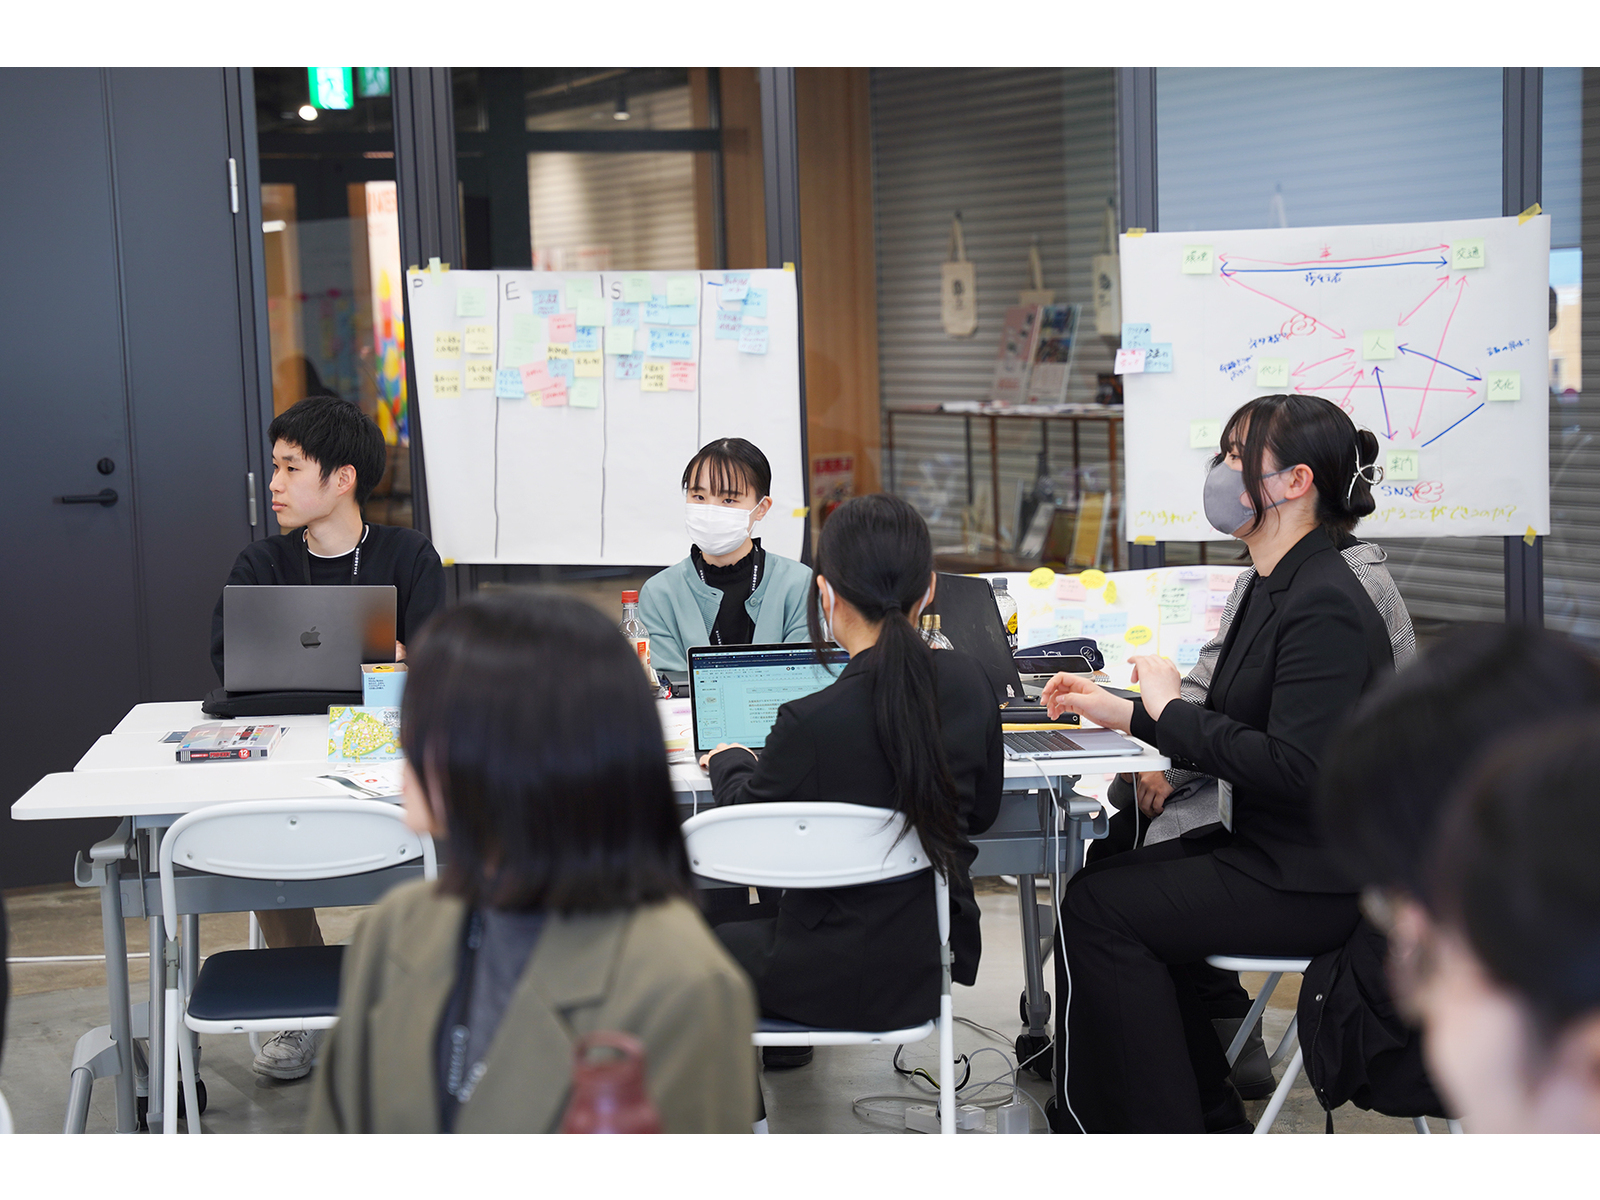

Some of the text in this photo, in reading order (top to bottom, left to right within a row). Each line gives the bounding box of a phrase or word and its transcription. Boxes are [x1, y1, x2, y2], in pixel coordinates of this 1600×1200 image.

[1456, 246, 1481, 260] 交通
[505, 281, 520, 300] E
[611, 281, 622, 300] S
[1371, 337, 1387, 351] 人
[1492, 378, 1514, 392] 文化
[1381, 485, 1414, 498] SNS
